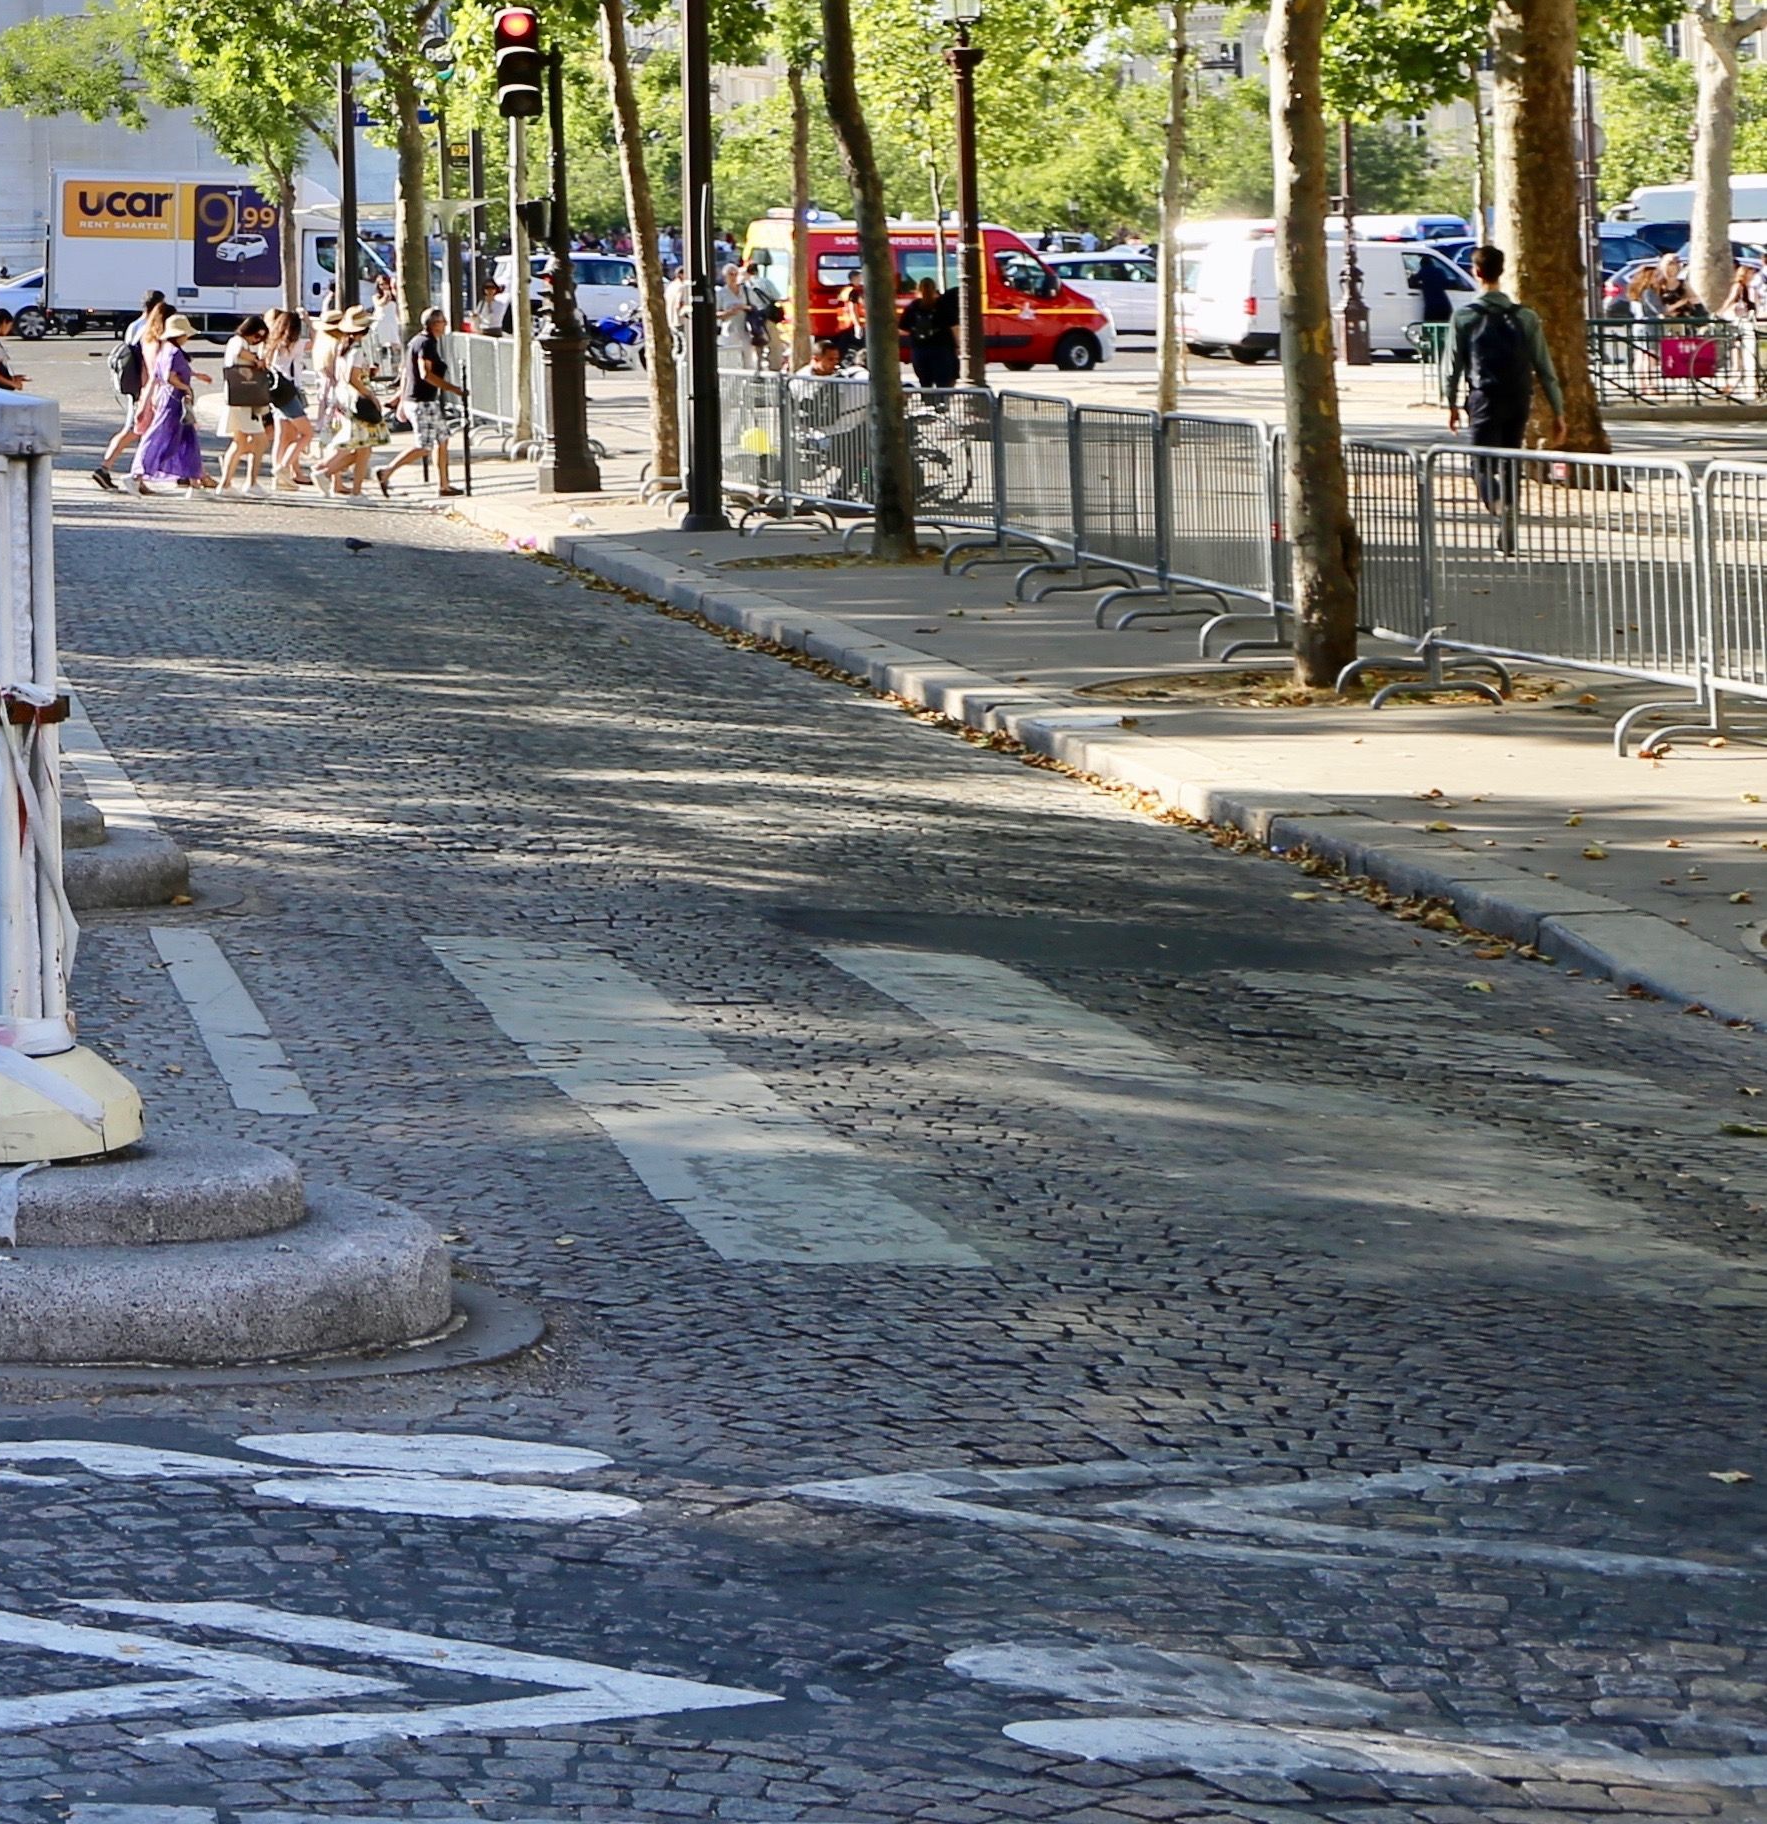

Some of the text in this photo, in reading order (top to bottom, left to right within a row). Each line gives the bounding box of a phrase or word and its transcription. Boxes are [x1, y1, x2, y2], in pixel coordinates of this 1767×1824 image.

[79, 191, 173, 218] ucar
[79, 220, 168, 230] RENT SMARTER
